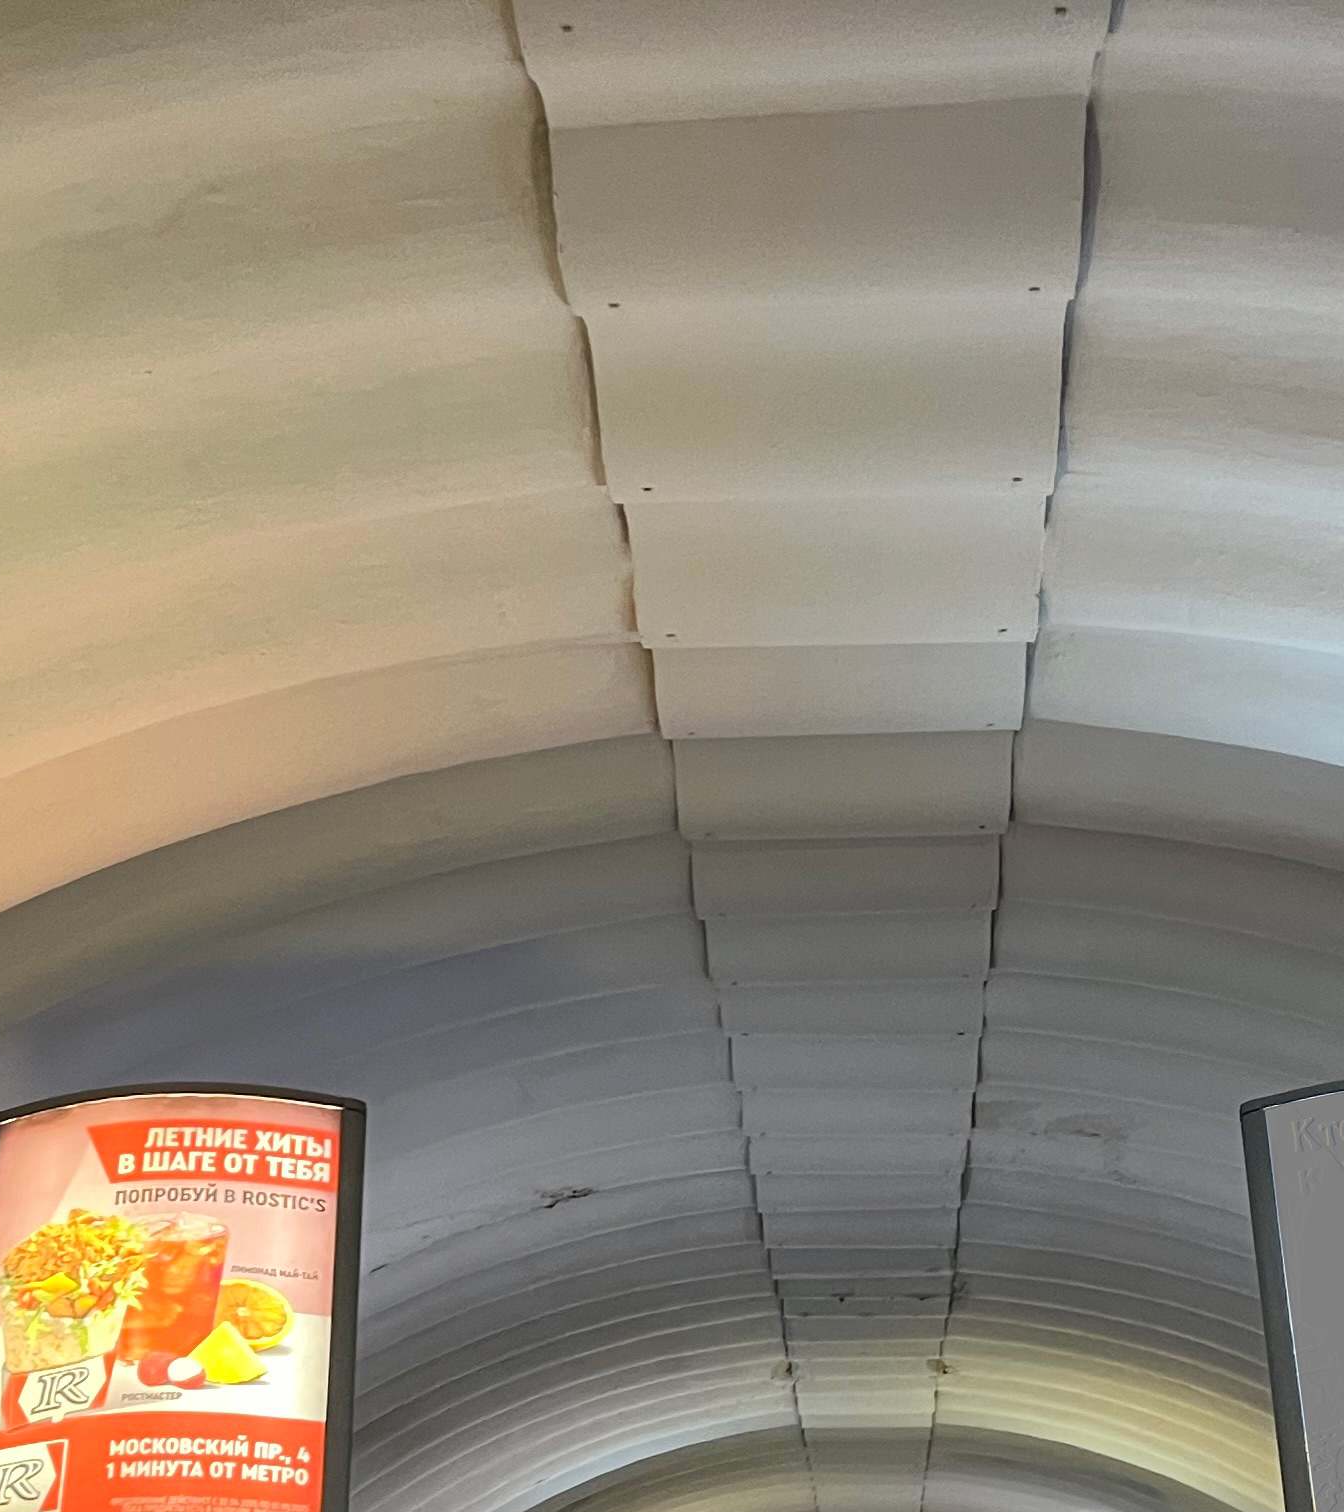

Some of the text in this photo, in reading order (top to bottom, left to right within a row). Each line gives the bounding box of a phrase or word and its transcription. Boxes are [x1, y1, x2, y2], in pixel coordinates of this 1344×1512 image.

[144, 1127, 331, 1158] ЛЕТНИЕ ХИТЫ
[117, 1152, 331, 1183] В ШАГЕ ОТ ТЕБЯ
[115, 1183, 326, 1212] ПОПРОБУЙ В ROSTIC'S
[109, 1435, 311, 1464] МОСКОВСКИЙ ПР., 4
[106, 1460, 309, 1486] 1 МИНУТА ОТ МЕТРО
